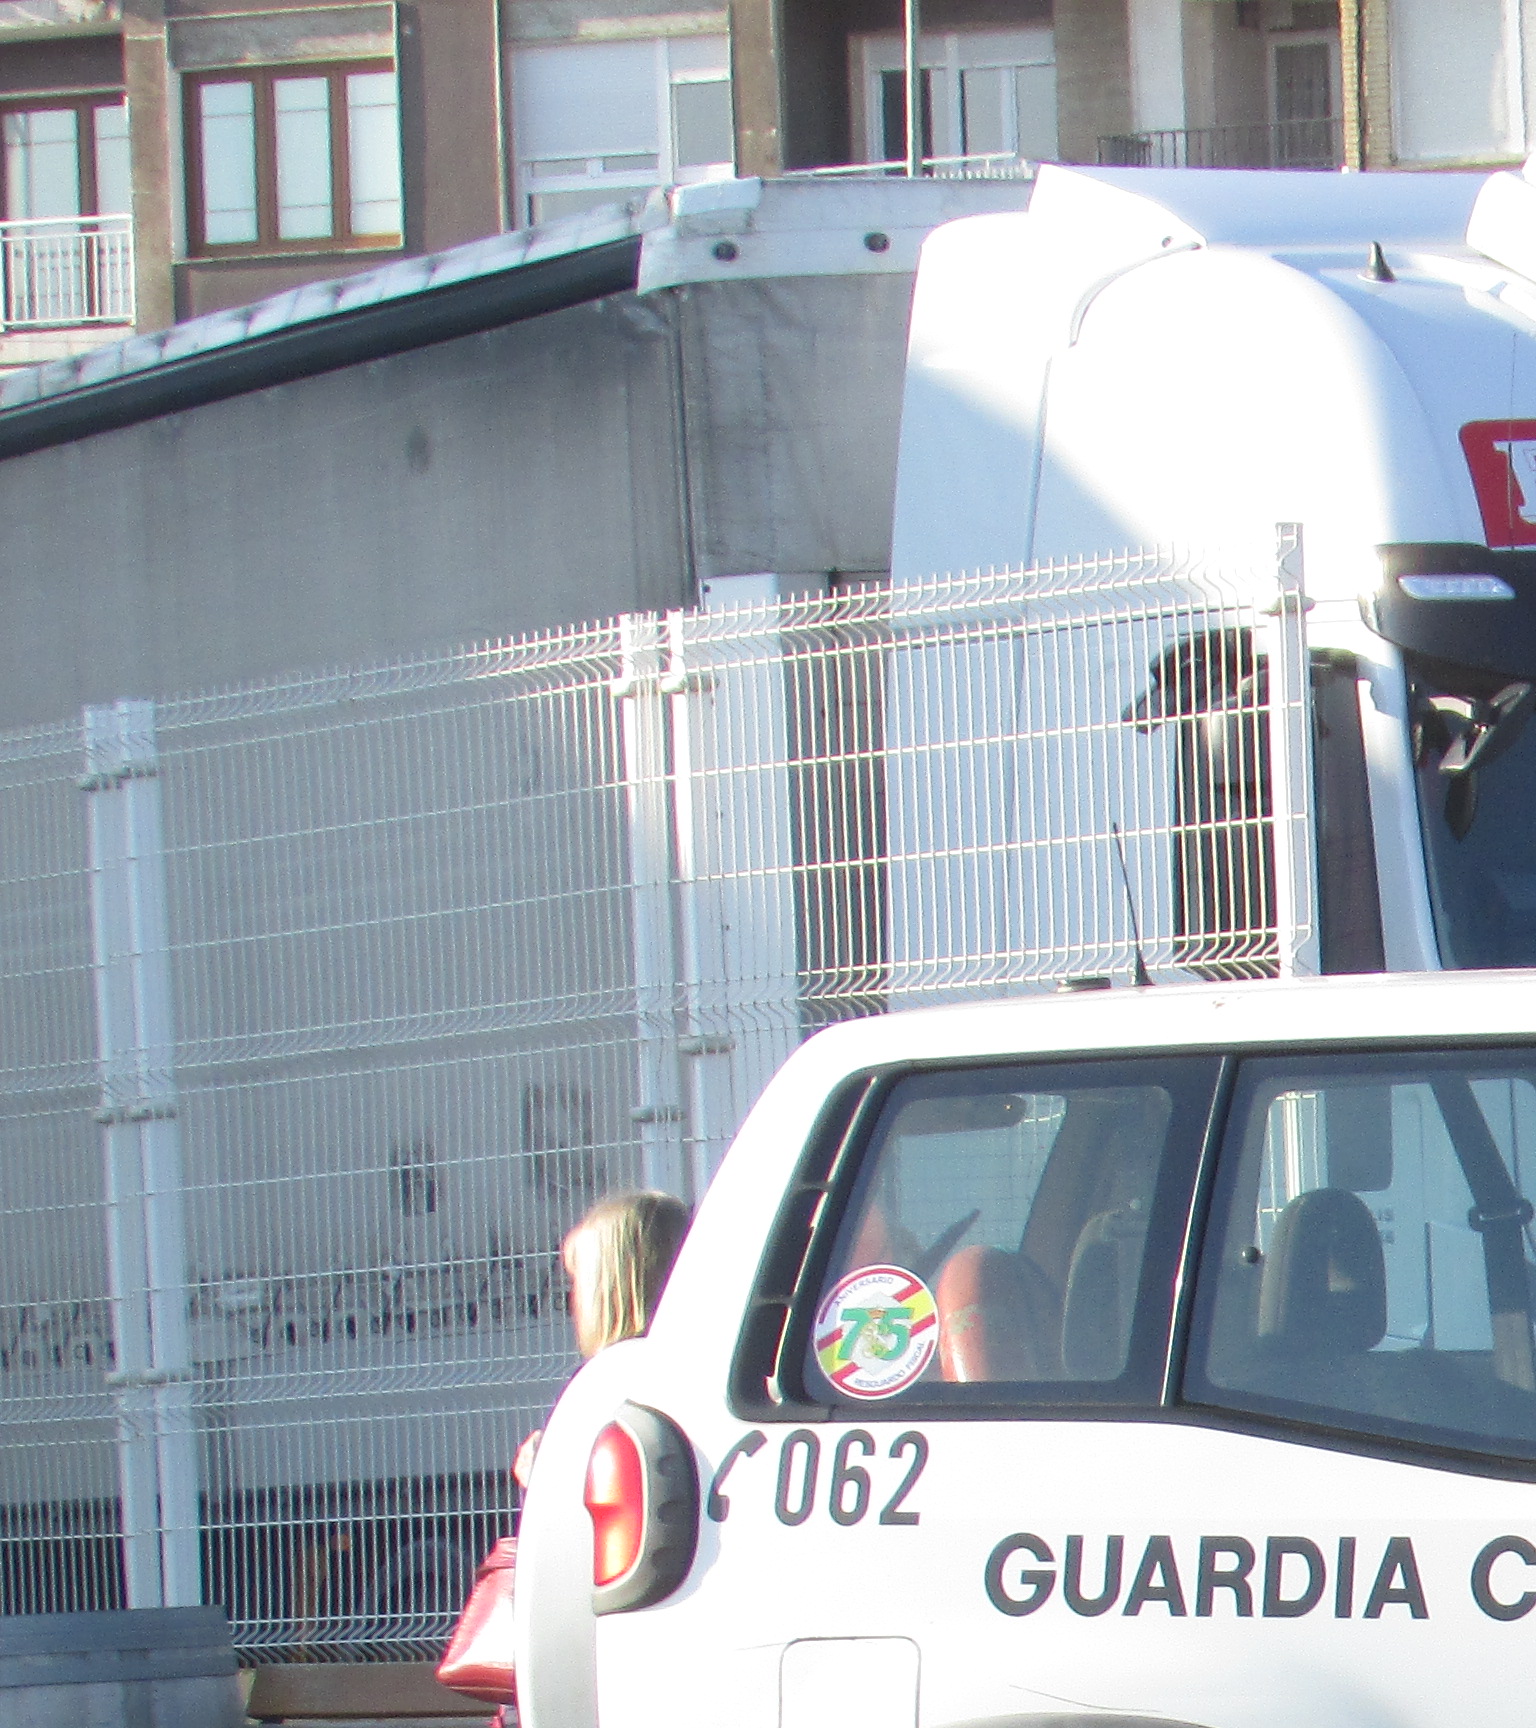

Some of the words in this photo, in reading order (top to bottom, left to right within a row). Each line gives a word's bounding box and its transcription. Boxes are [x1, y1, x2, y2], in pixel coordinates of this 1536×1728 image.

[838, 1307, 915, 1360] 75
[774, 1428, 928, 1526] 062
[984, 1531, 1429, 1620] GUARDIA
